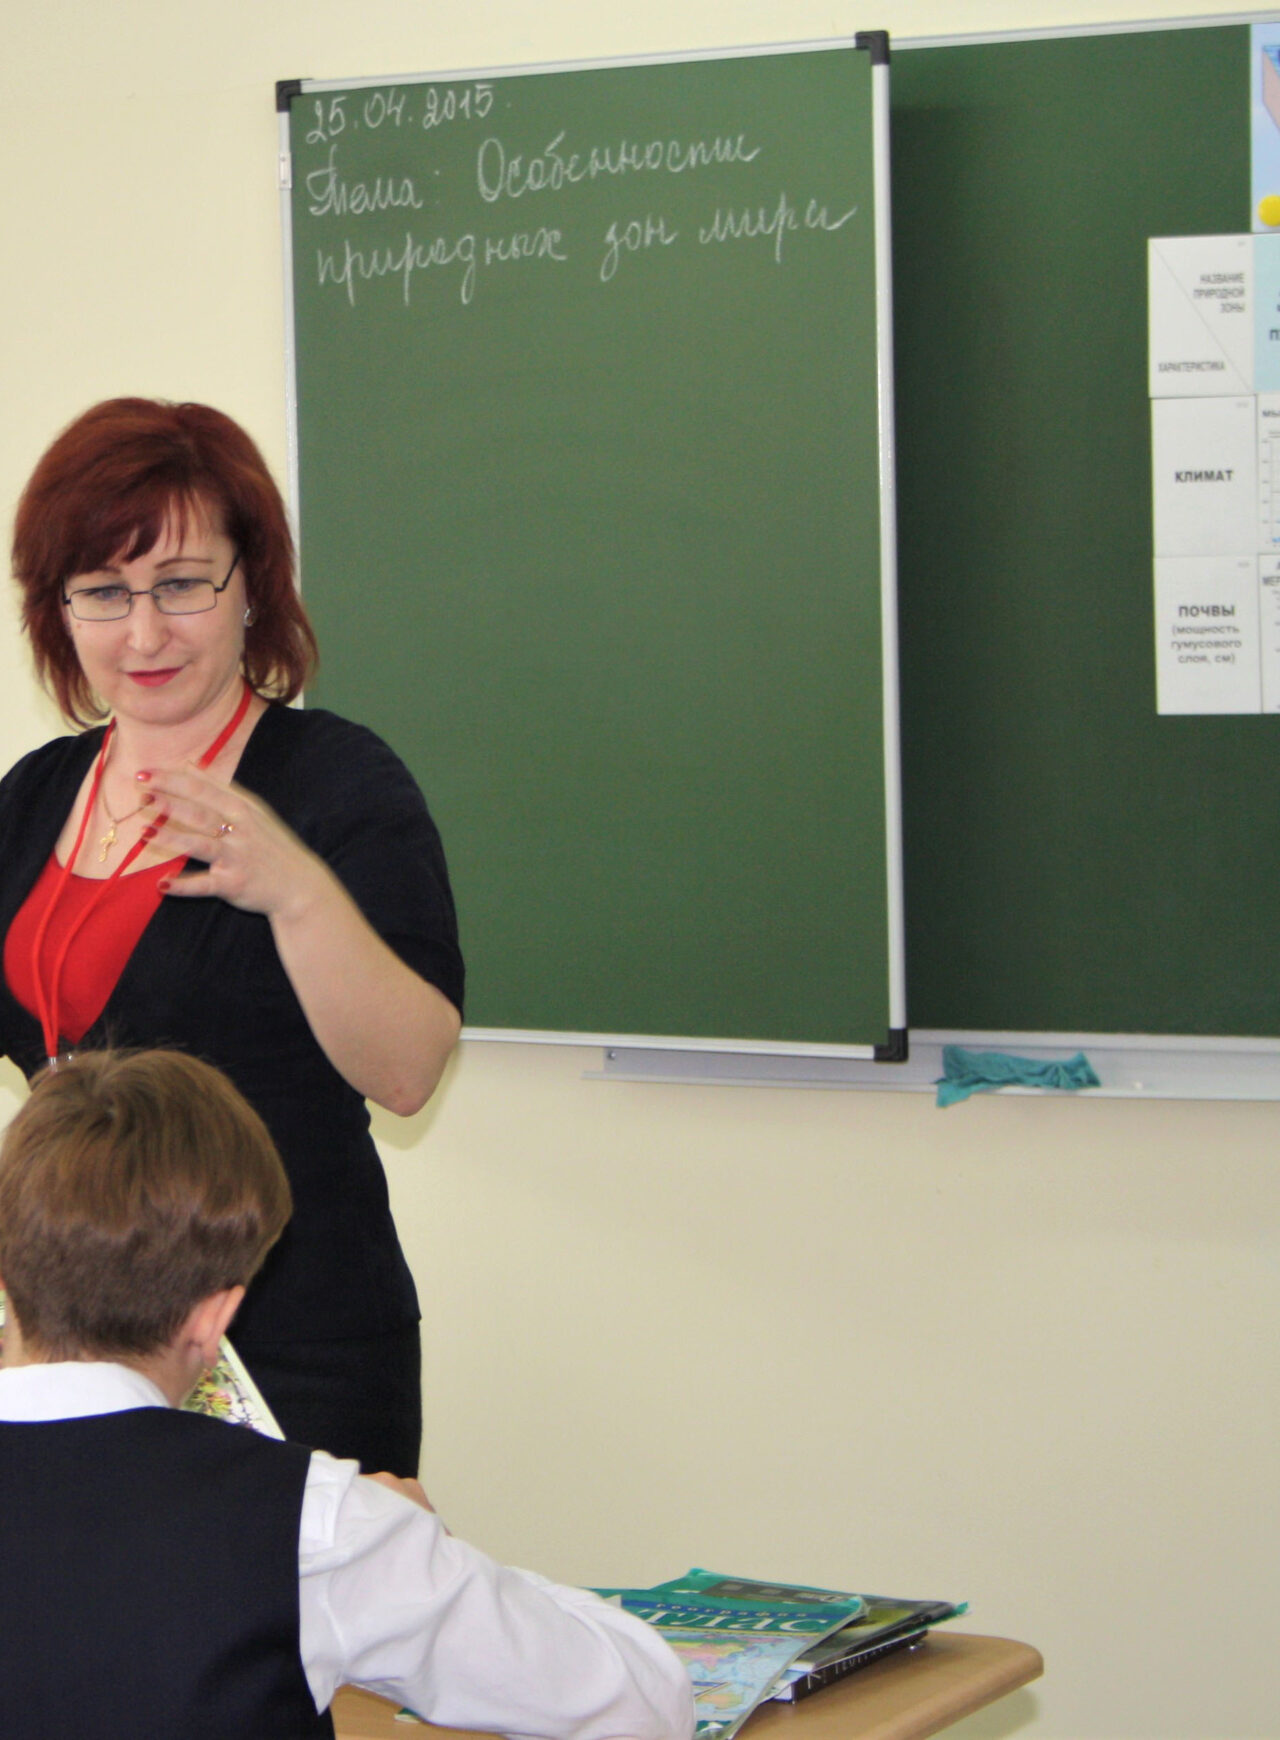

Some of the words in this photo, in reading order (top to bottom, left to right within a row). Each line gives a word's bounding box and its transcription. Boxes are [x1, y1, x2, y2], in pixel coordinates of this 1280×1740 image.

[477, 130, 760, 202] Особенности
[316, 231, 568, 307] природных
[599, 213, 679, 282] зон
[699, 192, 858, 264] мира
[1175, 470, 1234, 483] КЛИМАТ
[1178, 605, 1235, 617] ПОЧВЫ
[1172, 625, 1239, 637] (мощность
[1171, 640, 1242, 651] гумусового
[1214, 653, 1235, 665] см)
